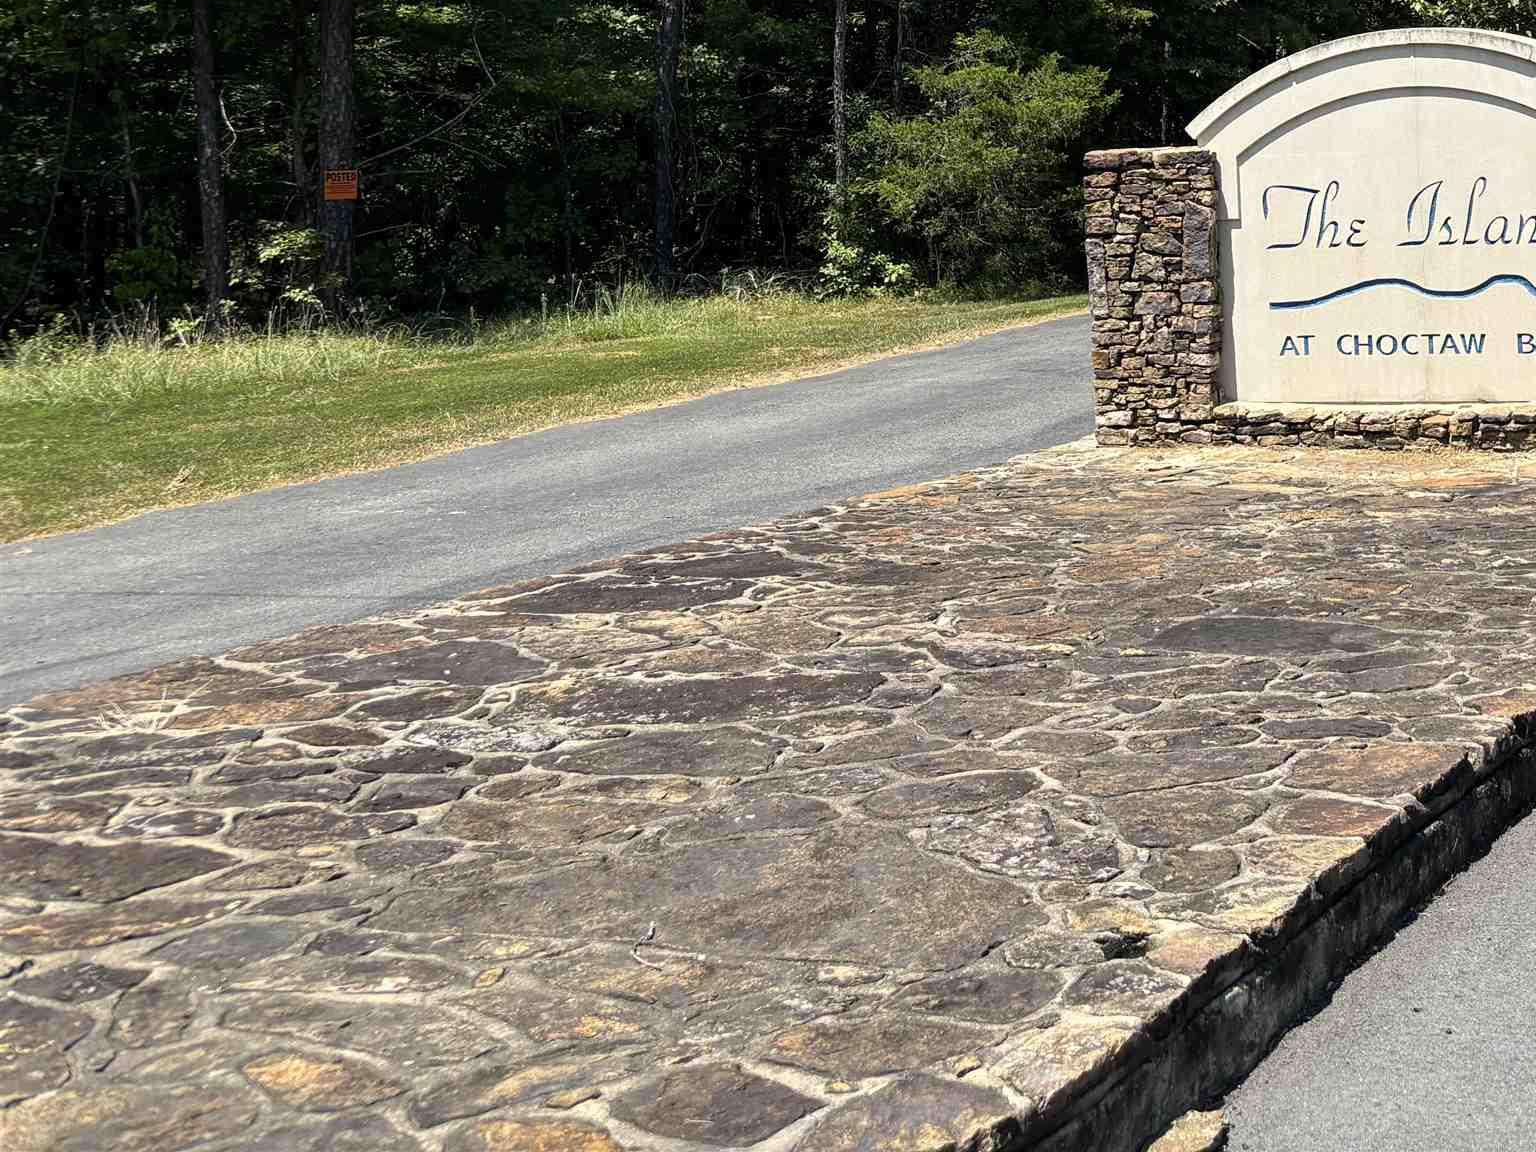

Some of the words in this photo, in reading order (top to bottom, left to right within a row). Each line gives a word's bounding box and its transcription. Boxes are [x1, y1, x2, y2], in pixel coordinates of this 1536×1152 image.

[1262, 180, 1370, 249] The
[1279, 334, 1316, 356] AT
[1336, 333, 1488, 356] CHOCTAW
